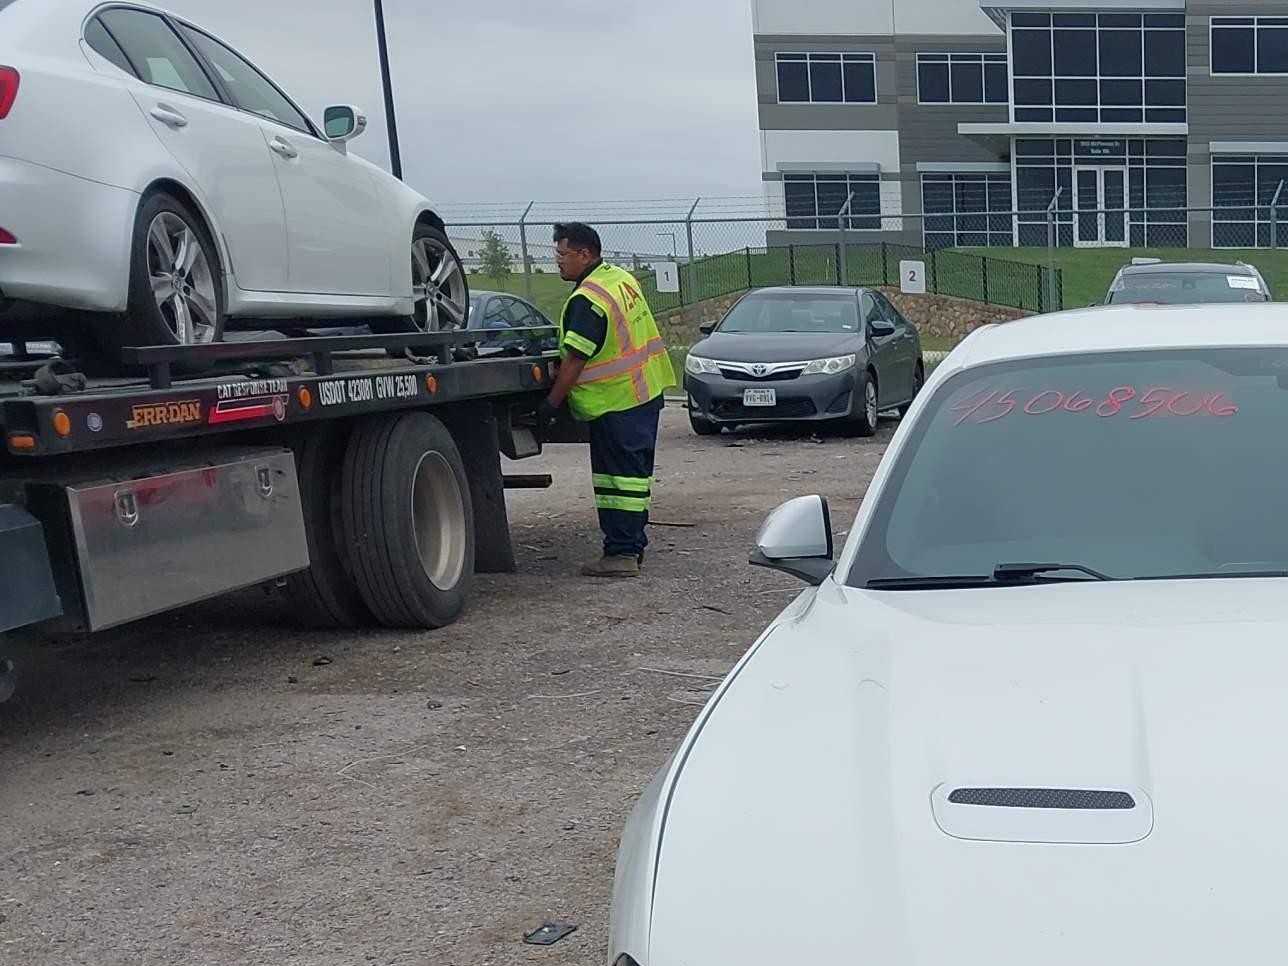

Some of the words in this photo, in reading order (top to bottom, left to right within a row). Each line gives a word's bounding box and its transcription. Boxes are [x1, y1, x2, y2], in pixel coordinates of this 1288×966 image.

[663, 271, 670, 282] 1
[909, 270, 917, 282] 2
[217, 383, 233, 399] CAT
[318, 380, 346, 405] USDOT
[375, 375, 395, 399] GVW
[395, 374, 418, 398] 25,500
[949, 383, 1240, 427] 45068506
